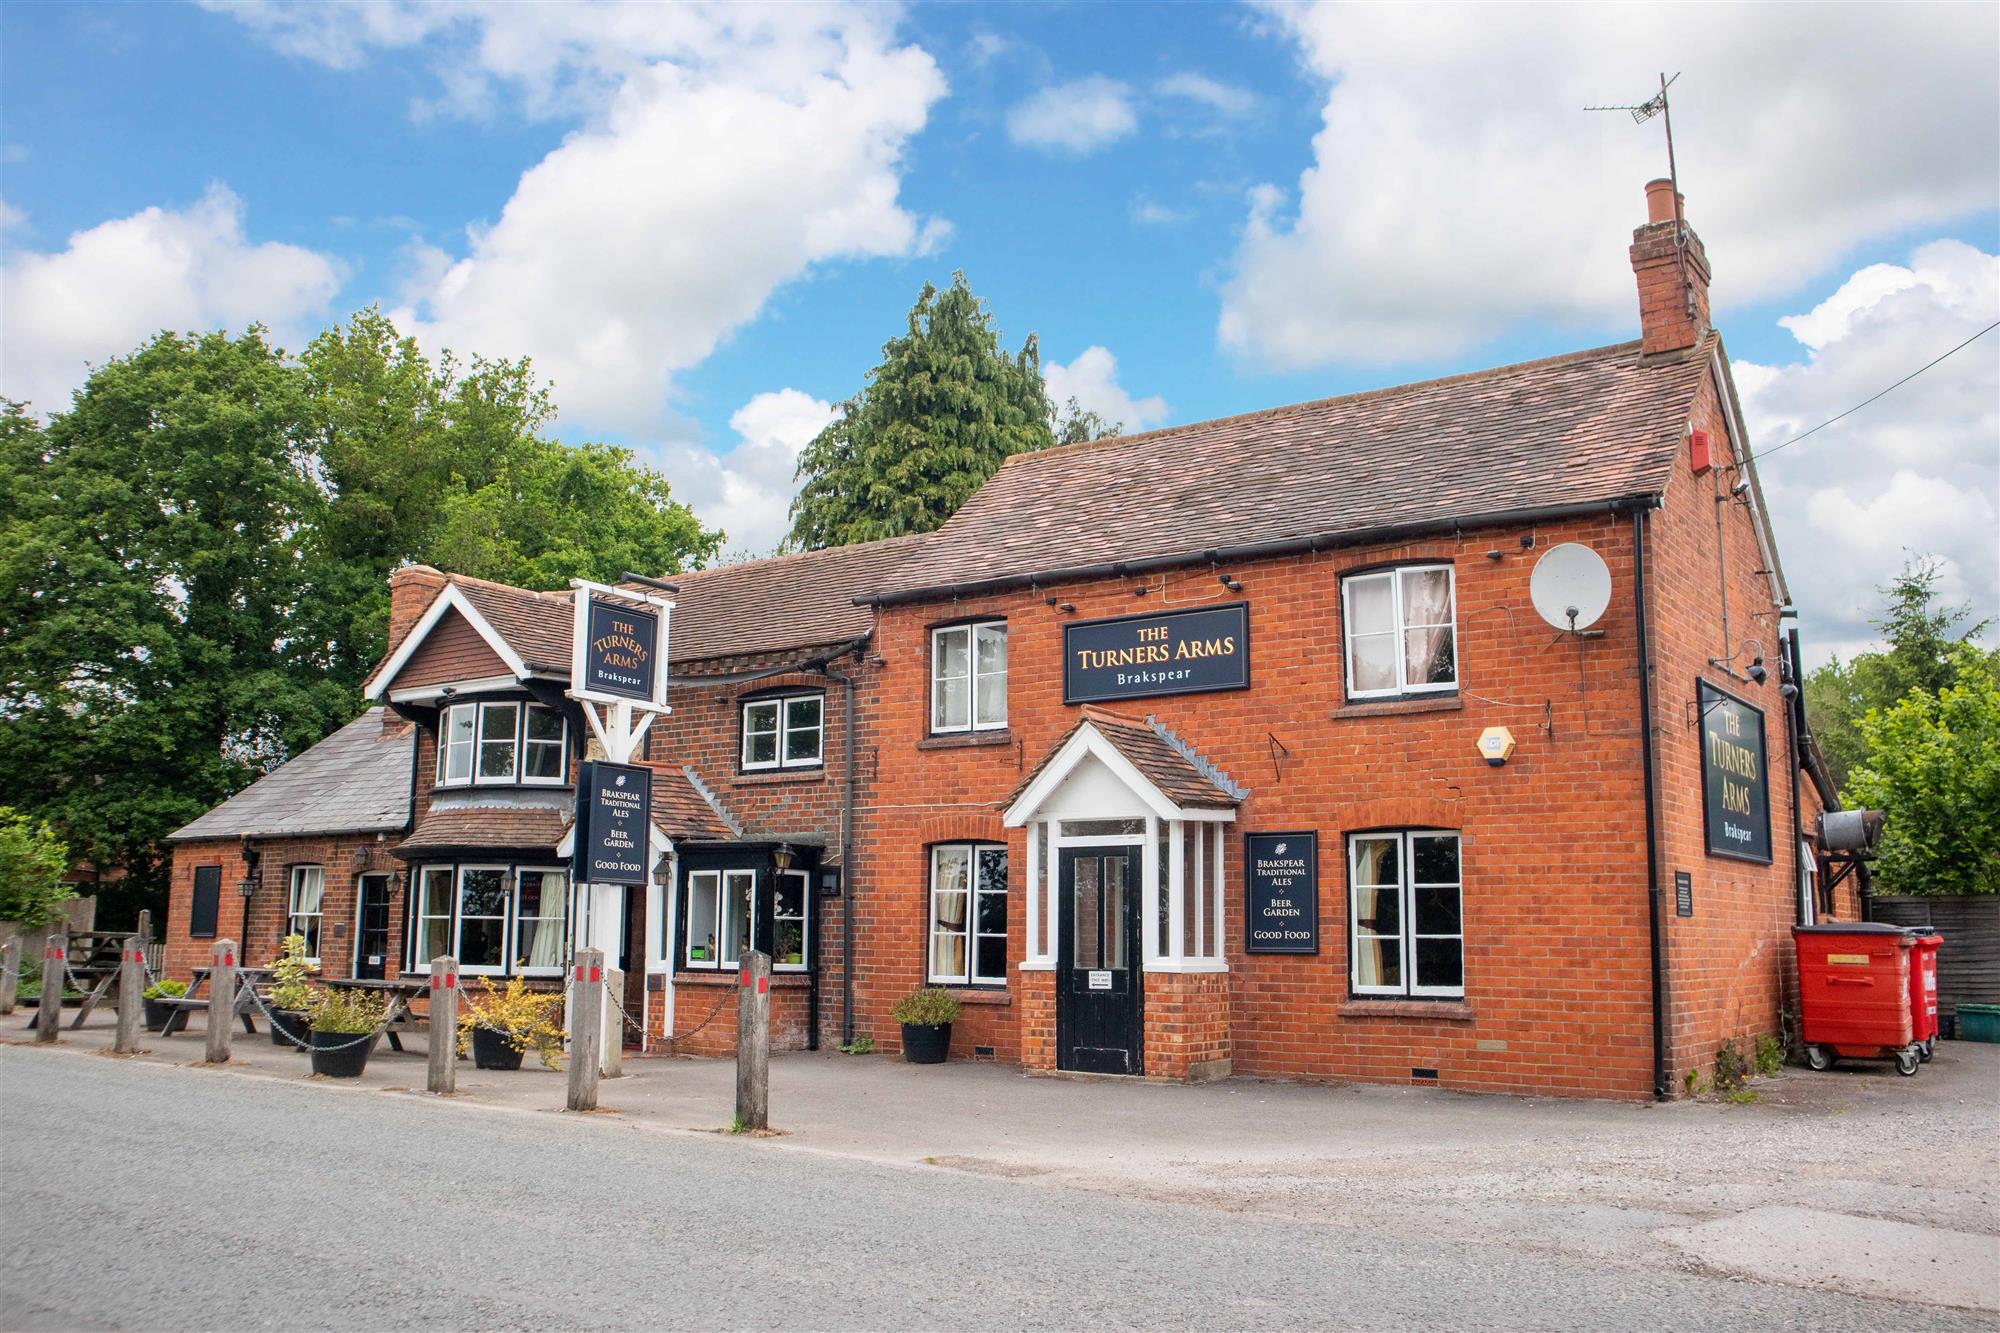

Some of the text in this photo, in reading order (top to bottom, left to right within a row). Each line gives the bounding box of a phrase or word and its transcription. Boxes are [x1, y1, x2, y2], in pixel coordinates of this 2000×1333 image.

[612, 621, 634, 635] THE
[1137, 626, 1168, 642] THE
[593, 635, 648, 661] TURNERS
[1077, 636, 1234, 670] TURNERS ARMS
[603, 652, 638, 669] ARMS
[598, 670, 641, 685] Brakspear
[1117, 669, 1191, 685] Brakspear
[1724, 710, 1740, 737] THE
[1709, 730, 1756, 780] TURNERS
[601, 788, 640, 801] BRAKSPEAR
[1722, 775, 1750, 816] ARMS
[600, 798, 641, 809] TRADITIONAL
[612, 809, 629, 818] ALES
[610, 829, 628, 839] BEER
[1724, 821, 1752, 843] Brakspear
[604, 838, 634, 848] GARDEN
[595, 860, 641, 871] GOOD FOOD
[1257, 860, 1305, 868] BRAKSPEAR
[1271, 878, 1292, 886] ALES
[1271, 899, 1292, 907] BEER
[1263, 908, 1300, 917] GARDEN
[1254, 930, 1310, 939] GOOD FOOD
